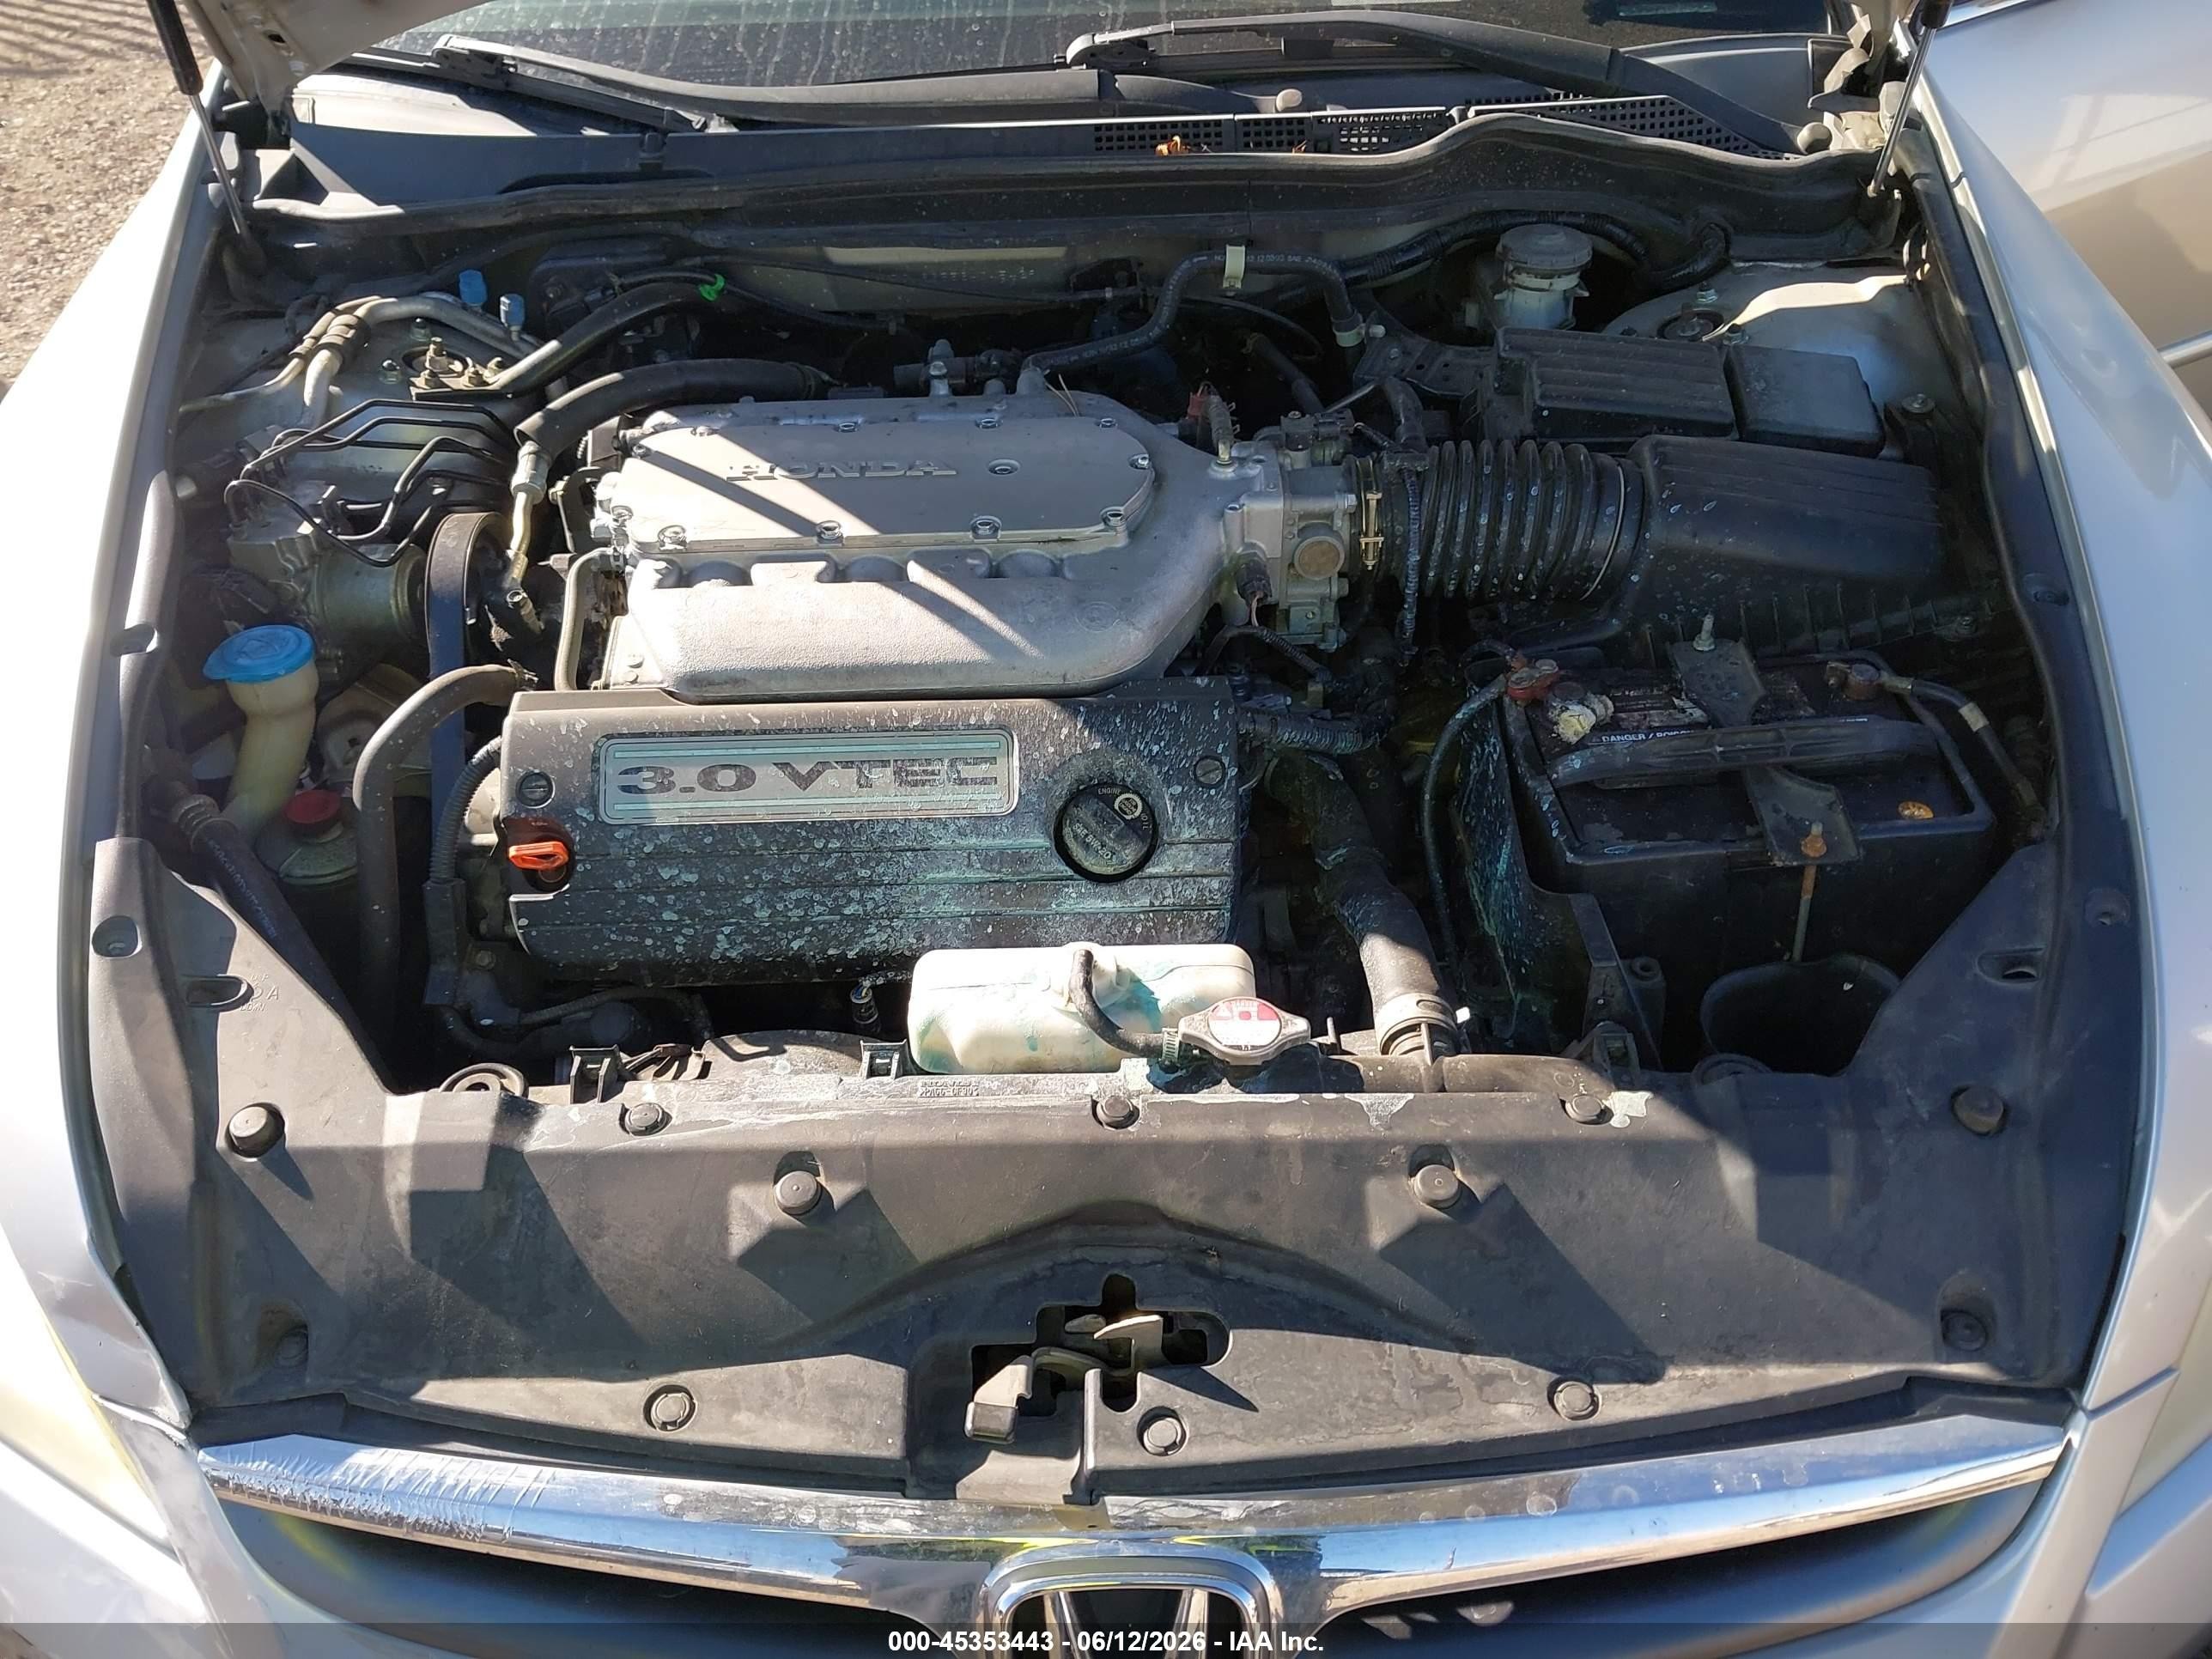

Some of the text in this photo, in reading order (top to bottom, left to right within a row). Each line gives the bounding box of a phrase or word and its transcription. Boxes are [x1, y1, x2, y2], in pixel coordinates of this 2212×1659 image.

[726, 459, 957, 482] HONDA
[1601, 733, 1646, 743] DANGER
[617, 757, 998, 795] 3.0 VTEC
[1073, 822, 1088, 838] SAE
